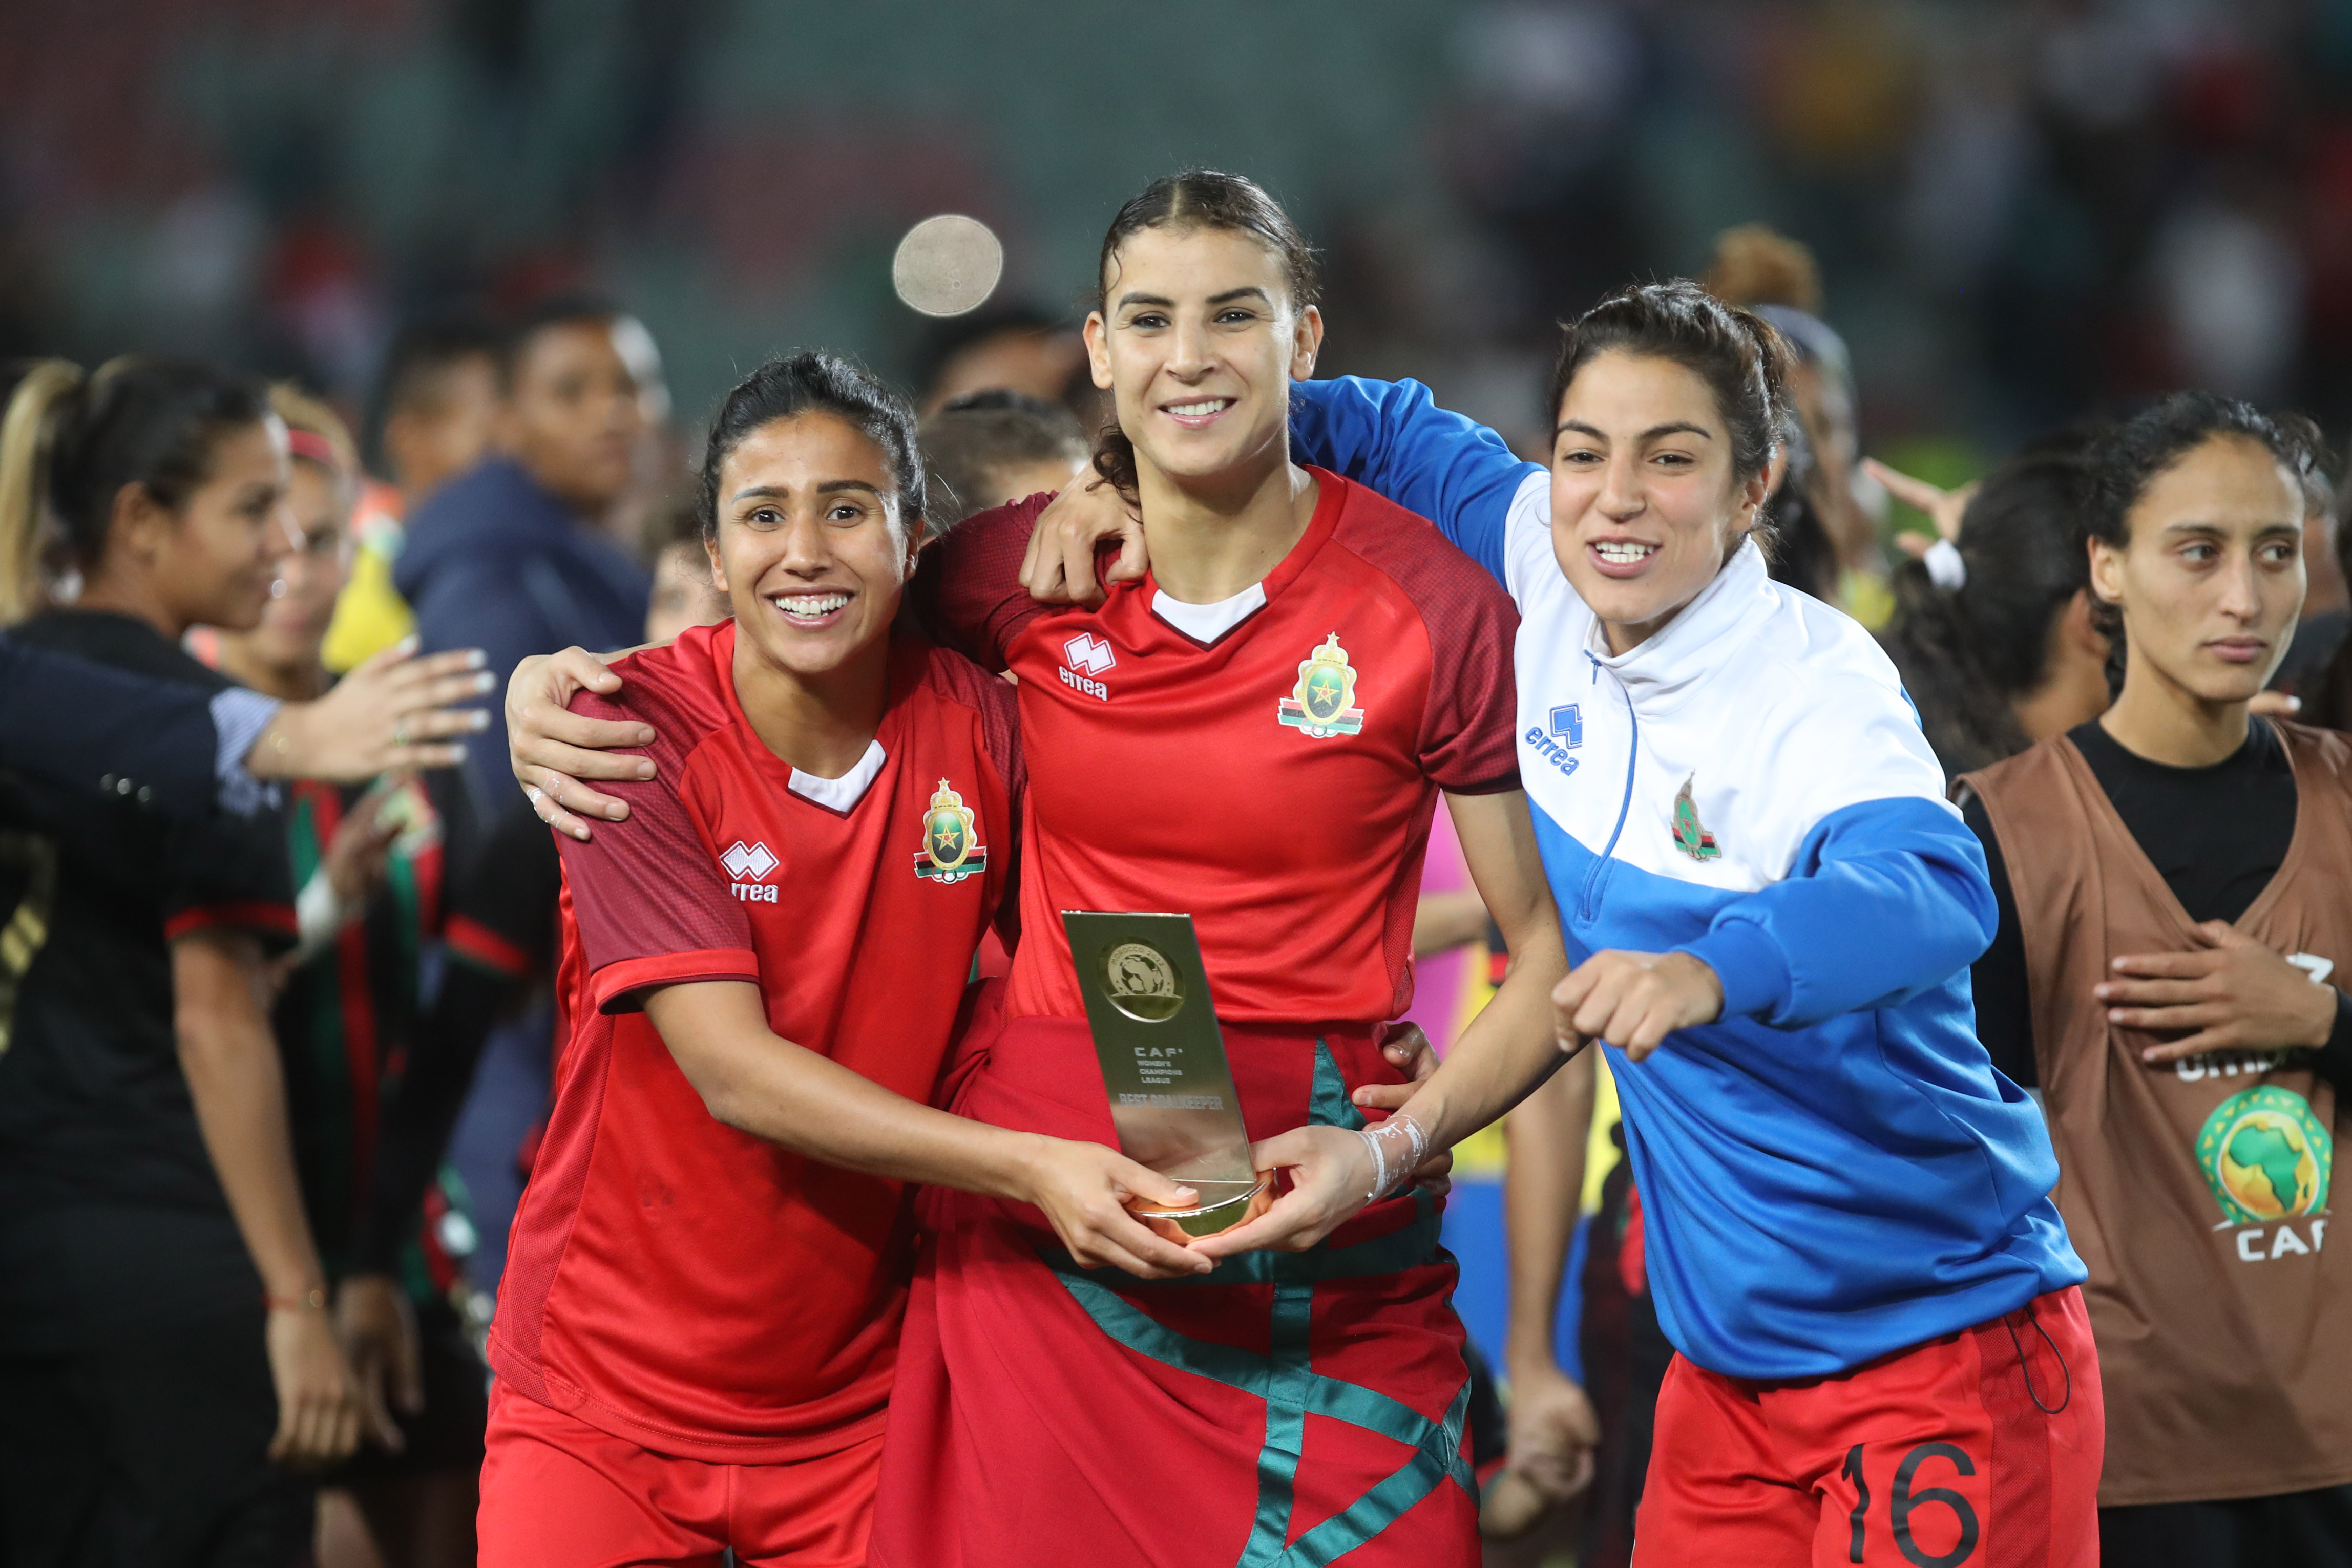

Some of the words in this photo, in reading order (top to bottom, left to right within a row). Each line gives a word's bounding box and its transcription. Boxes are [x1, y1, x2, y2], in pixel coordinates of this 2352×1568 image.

[1111, 946, 1144, 966] MOROCCO
[1147, 951, 1164, 966] 2022
[1119, 1093, 1148, 1107] BEST
[1150, 1094, 1223, 1110] GOALKEEPER
[1841, 1442, 1979, 1568] 16
